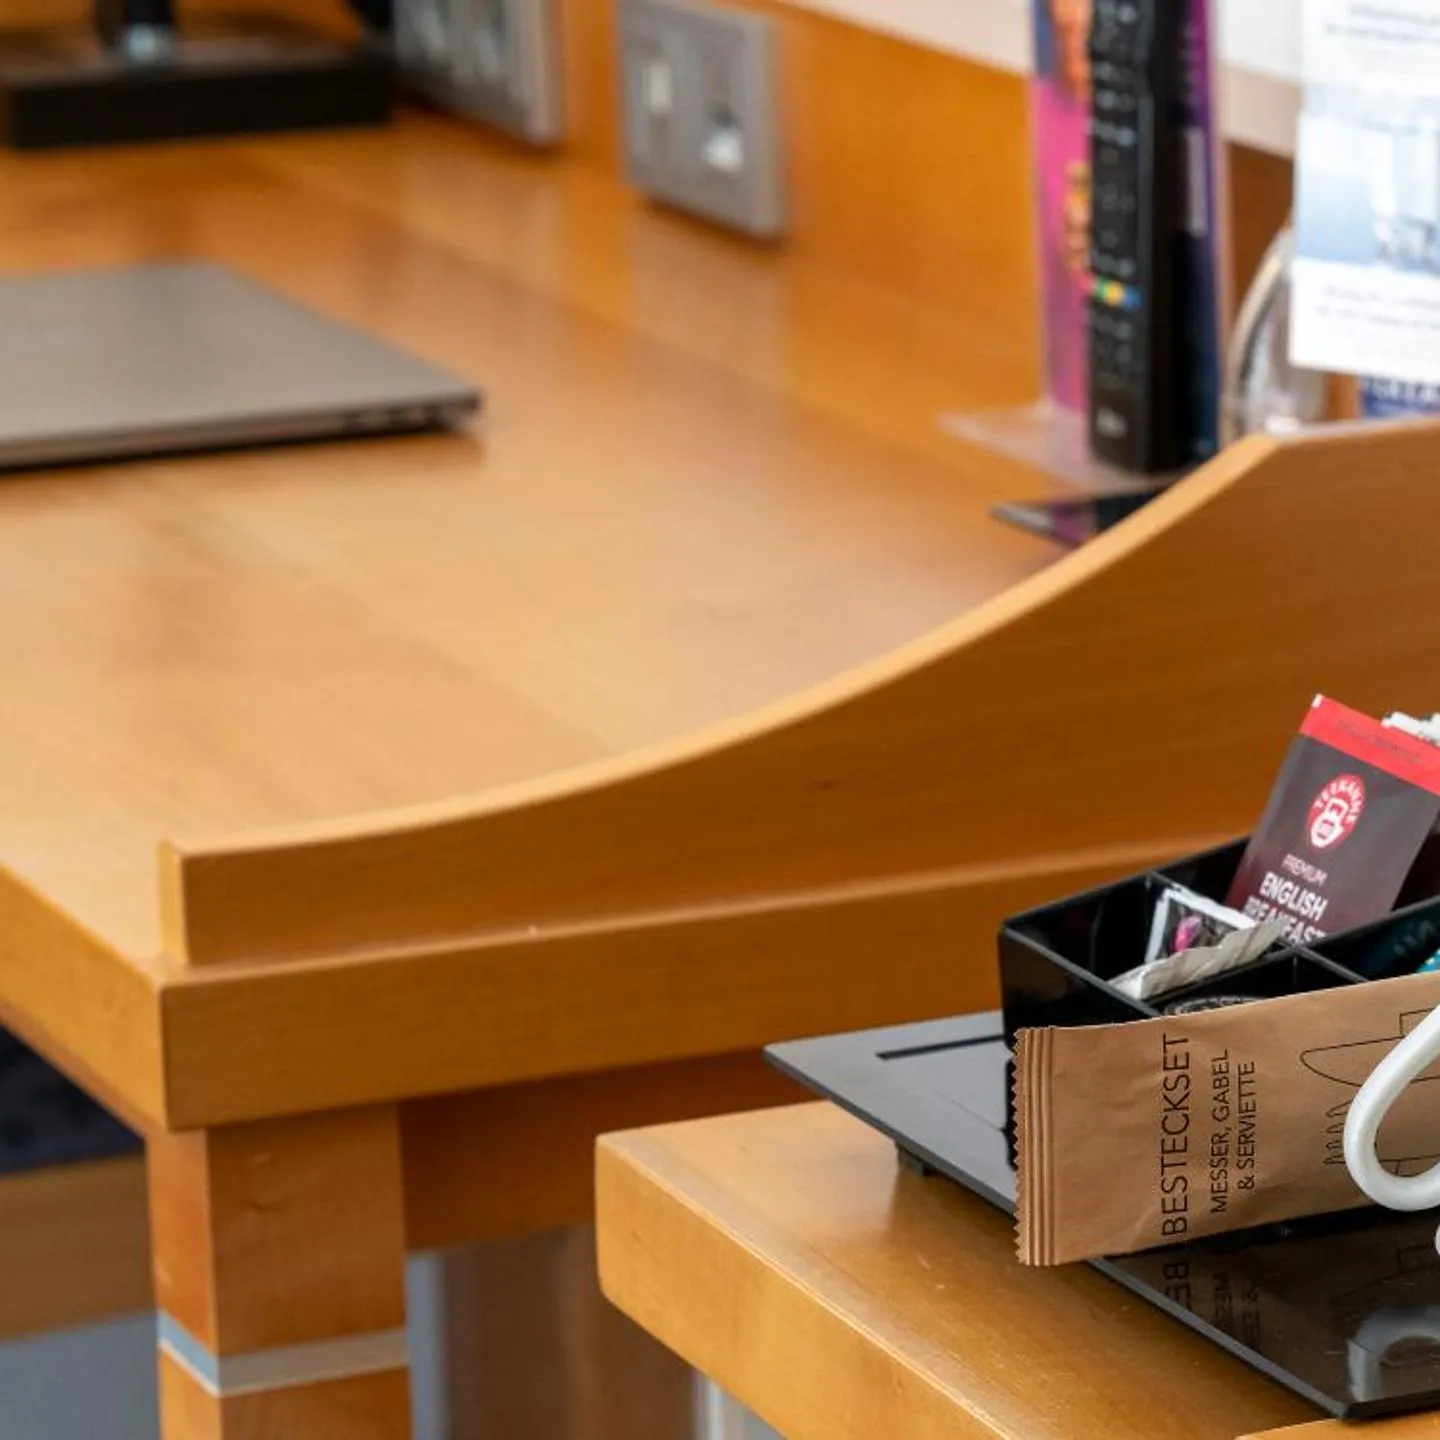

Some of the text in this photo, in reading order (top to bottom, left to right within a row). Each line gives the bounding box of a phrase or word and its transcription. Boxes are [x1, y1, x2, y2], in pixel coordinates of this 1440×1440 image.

[1259, 871, 1329, 922] ENGLISH
[1281, 853, 1328, 886] PREMIUM
[1161, 1033, 1190, 1236] BESTECKSET
[1209, 1048, 1233, 1214] MESSER, GABEL
[1236, 1061, 1257, 1190] & SERVIETTE
